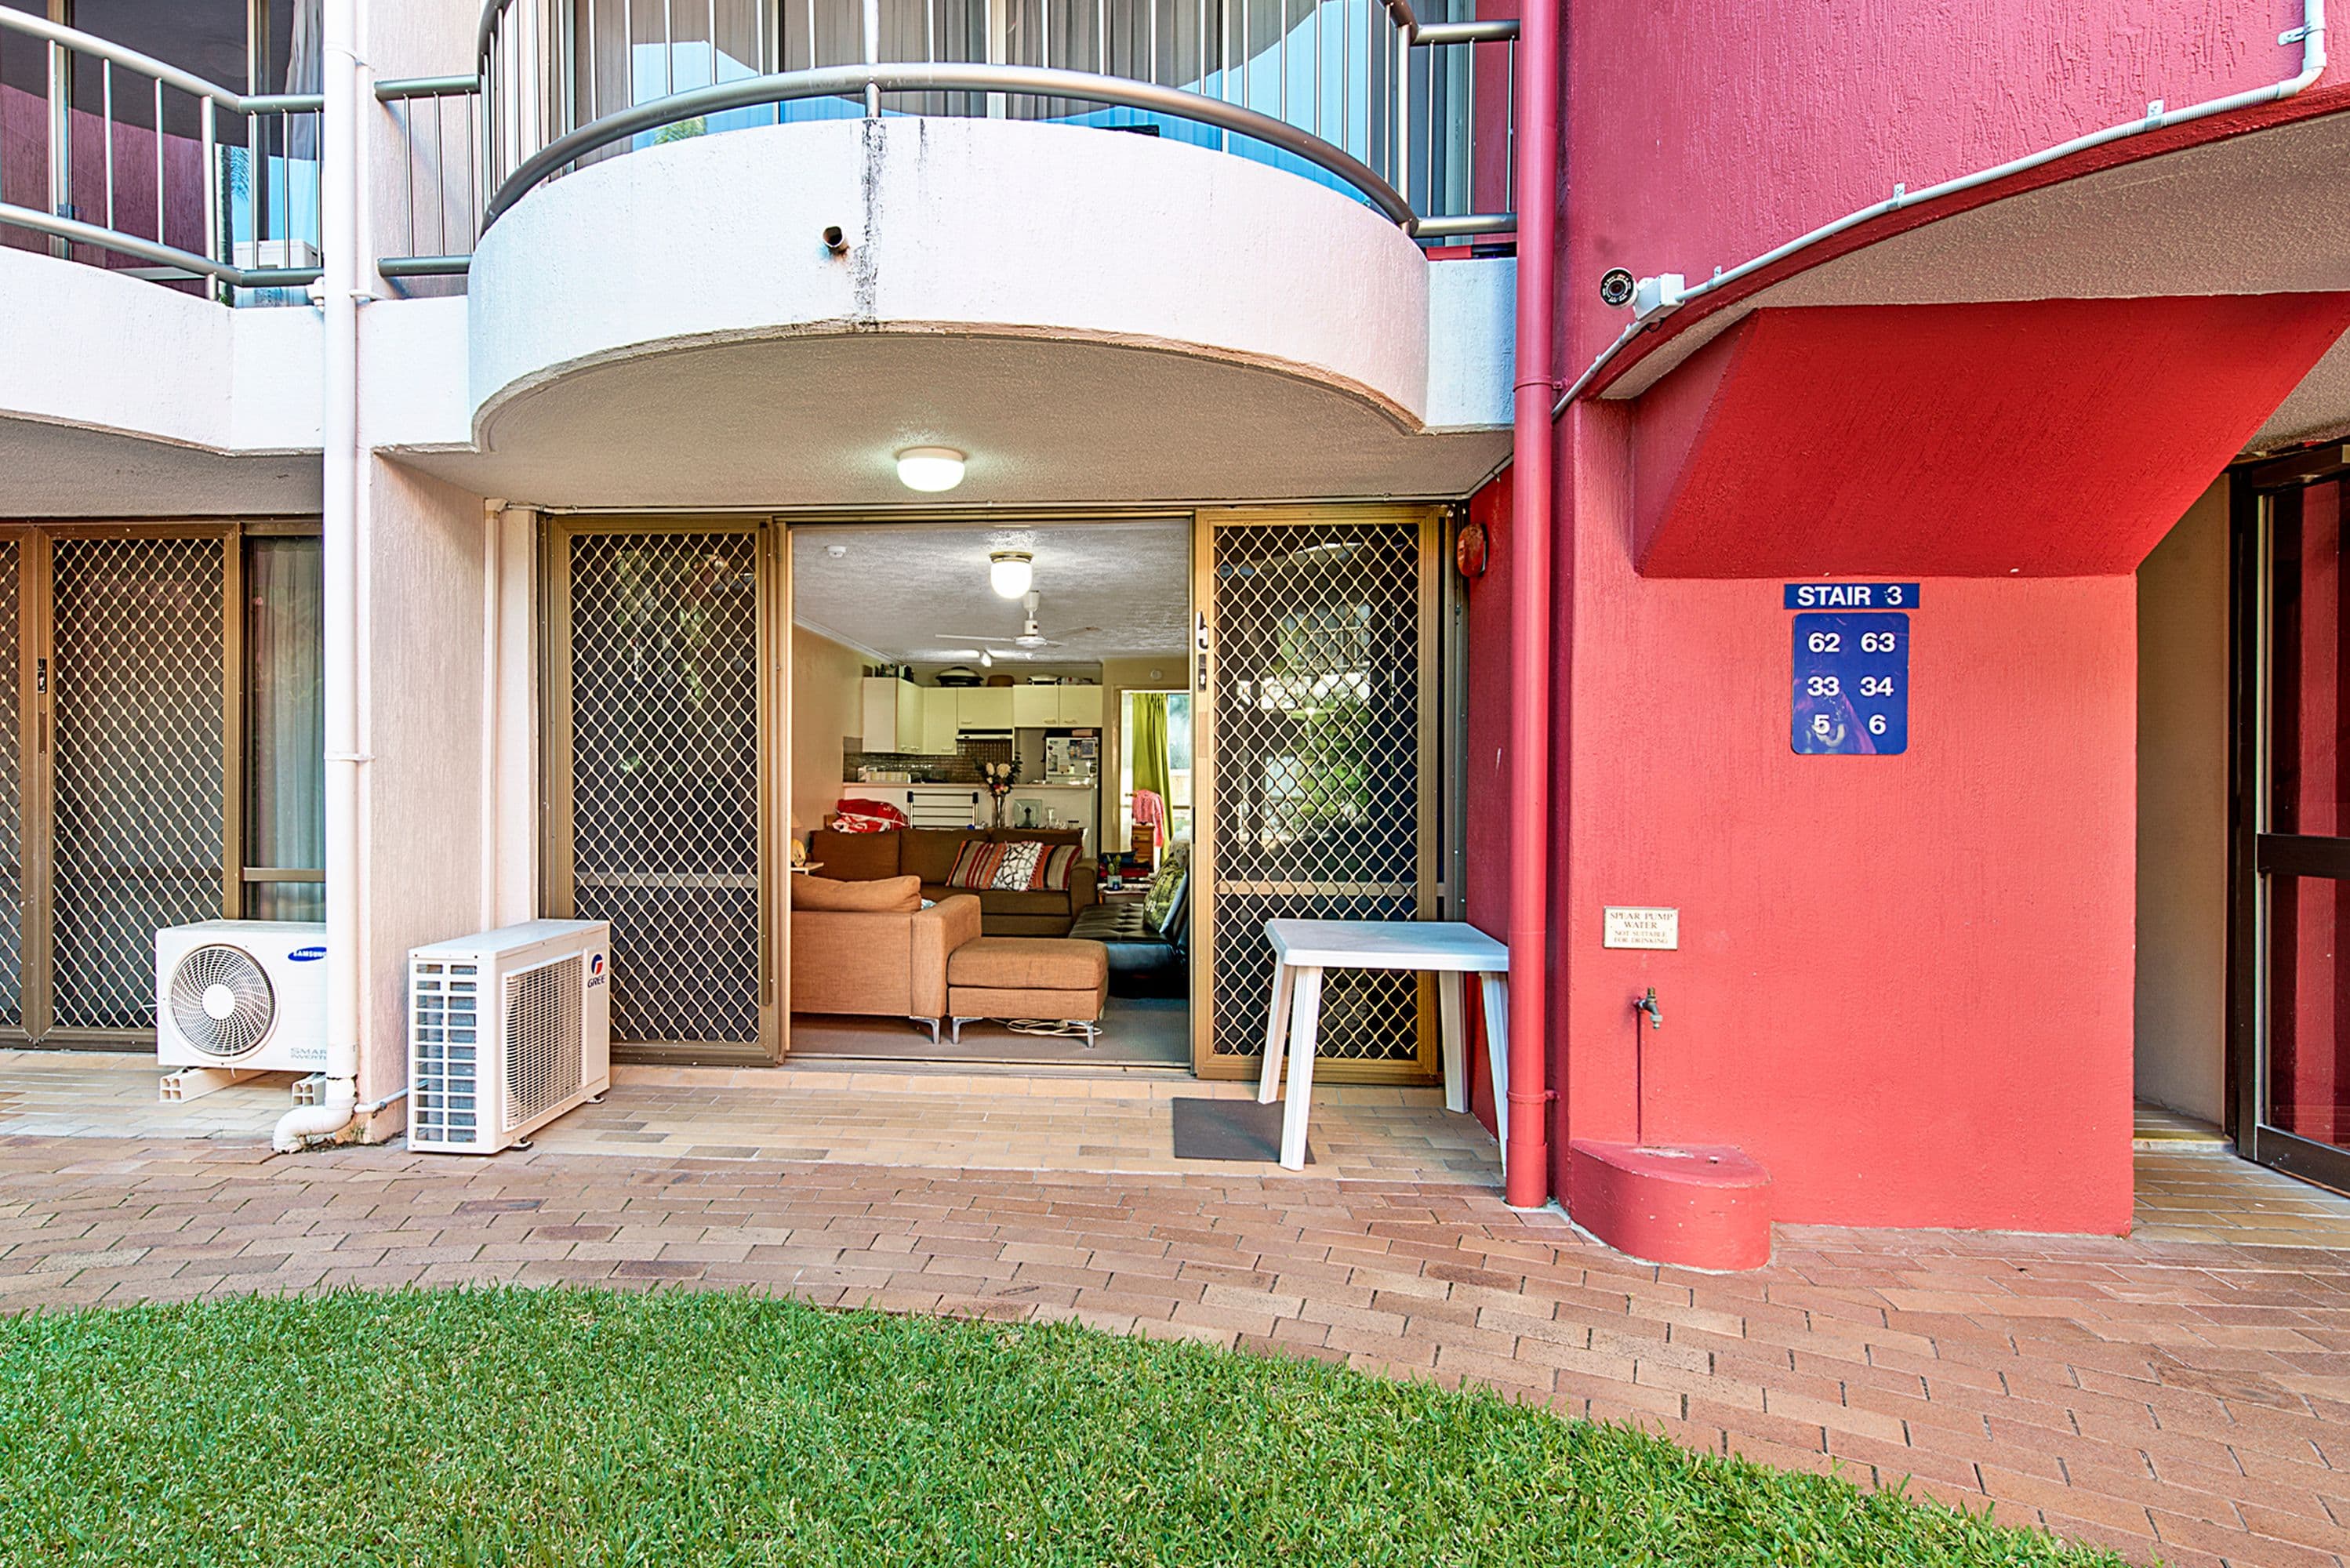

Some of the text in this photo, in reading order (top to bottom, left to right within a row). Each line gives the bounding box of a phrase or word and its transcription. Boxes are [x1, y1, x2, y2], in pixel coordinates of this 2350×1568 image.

[1797, 586, 1902, 606] STAIR 3
[1808, 633, 1895, 652] 62 63
[1807, 677, 1894, 696] 33 34
[1813, 714, 1887, 735] 5 6
[587, 974, 606, 988] GREE
